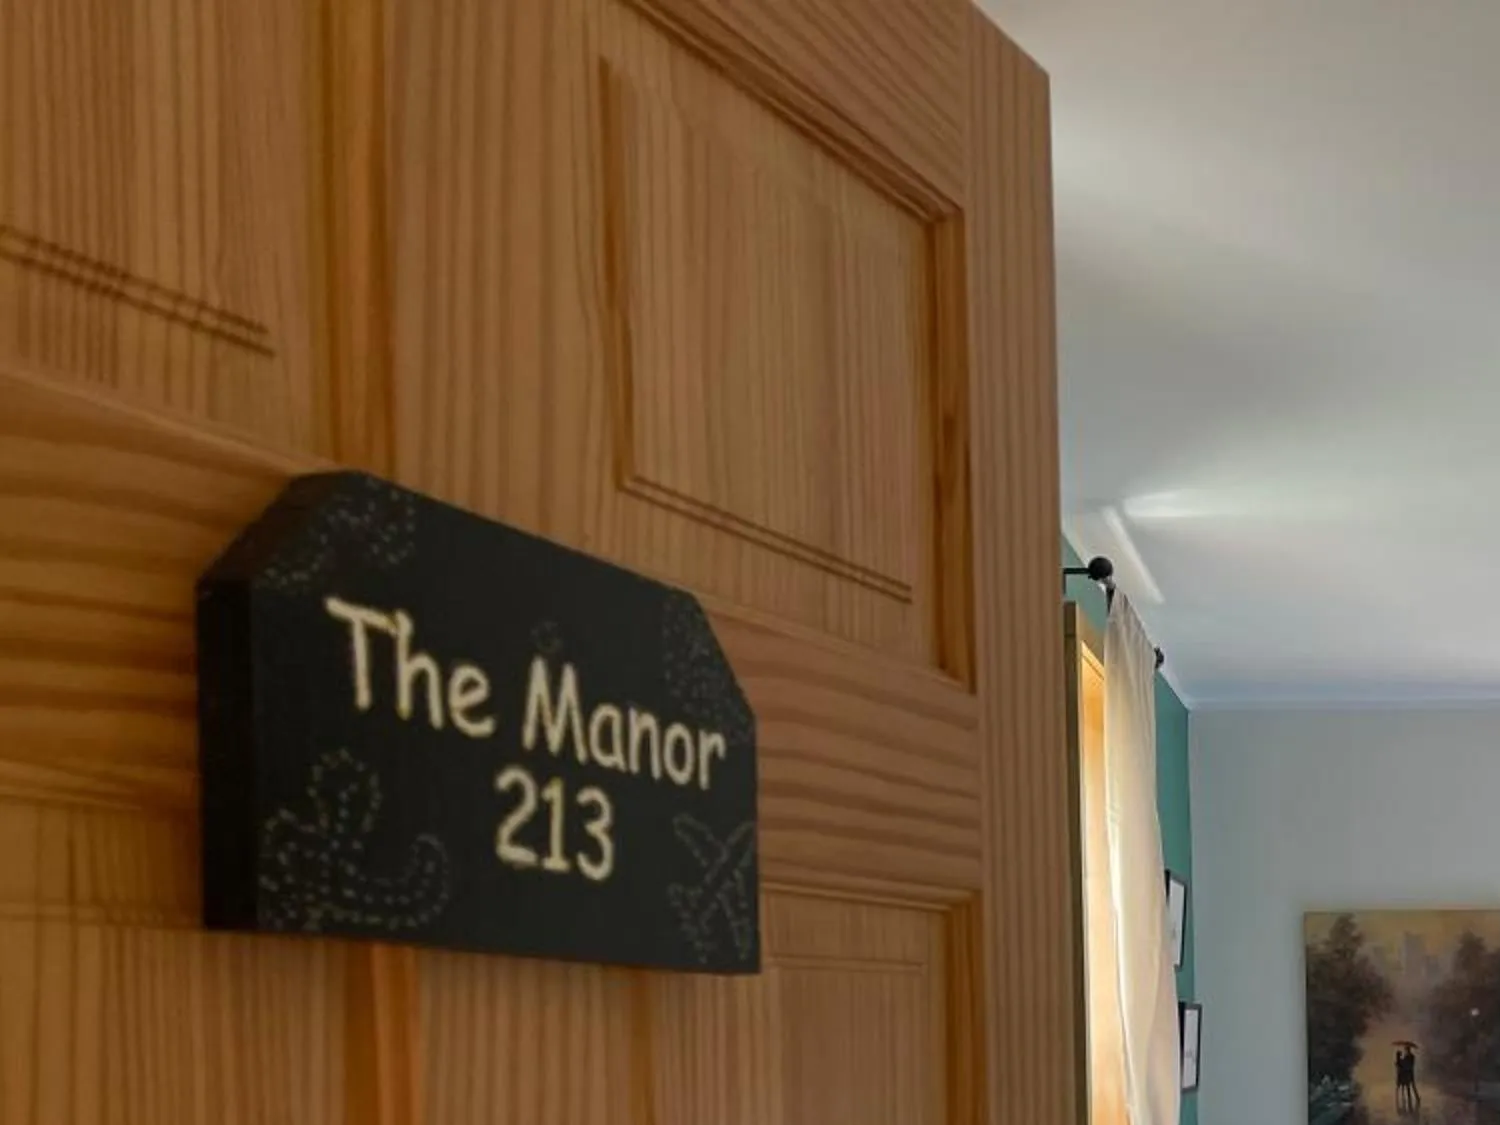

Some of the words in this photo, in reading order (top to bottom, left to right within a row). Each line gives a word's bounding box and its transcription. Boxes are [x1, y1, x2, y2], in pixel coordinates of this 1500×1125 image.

[325, 595, 497, 738] The
[522, 654, 726, 790] Manor
[495, 764, 614, 881] 213
